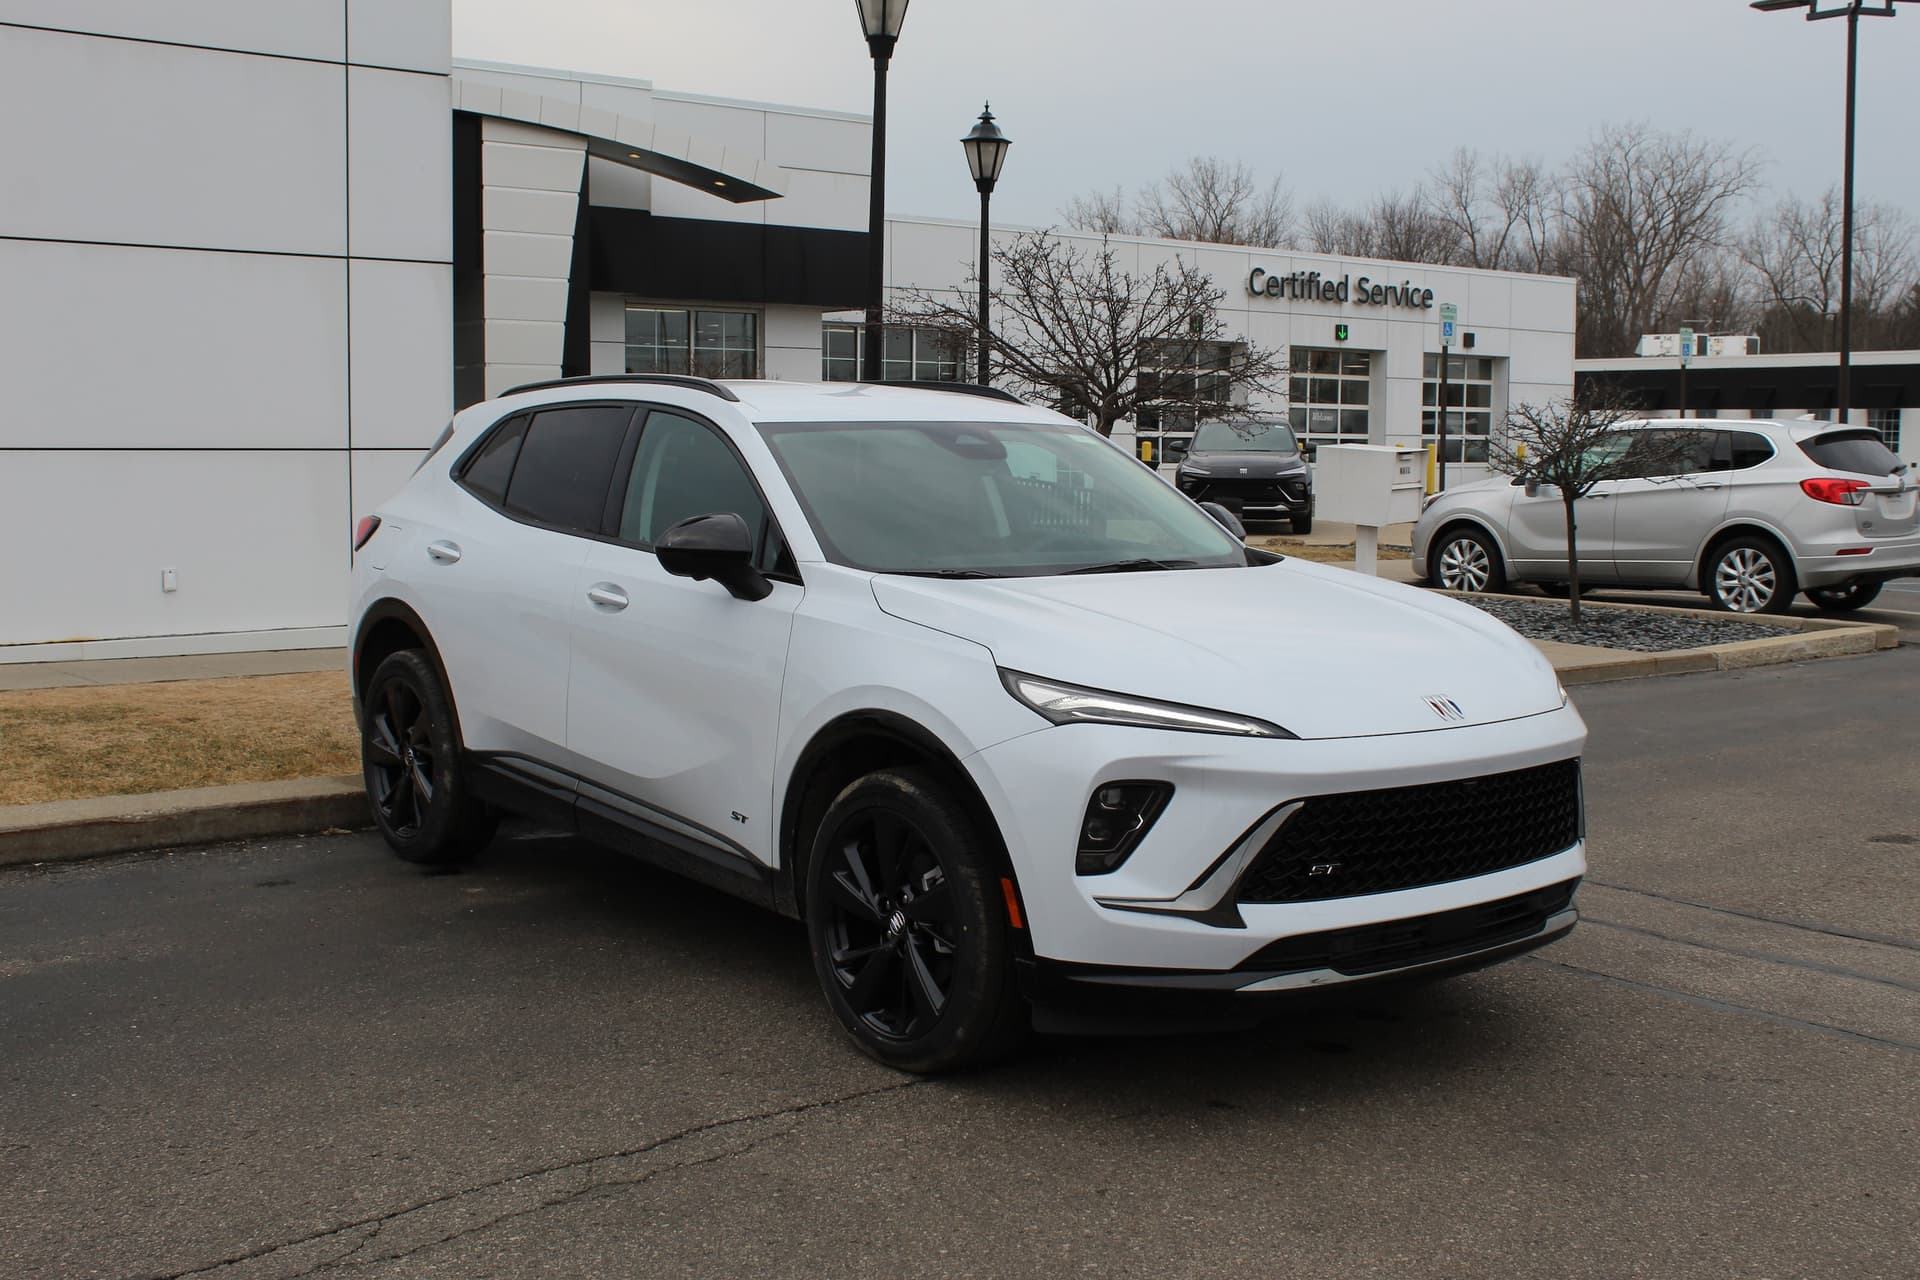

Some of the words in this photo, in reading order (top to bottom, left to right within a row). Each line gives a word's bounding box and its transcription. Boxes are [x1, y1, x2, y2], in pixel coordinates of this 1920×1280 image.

[1249, 267, 1349, 302] Certified
[1356, 277, 1434, 309] Service
[730, 810, 749, 824] ST
[1308, 863, 1342, 876] ST
